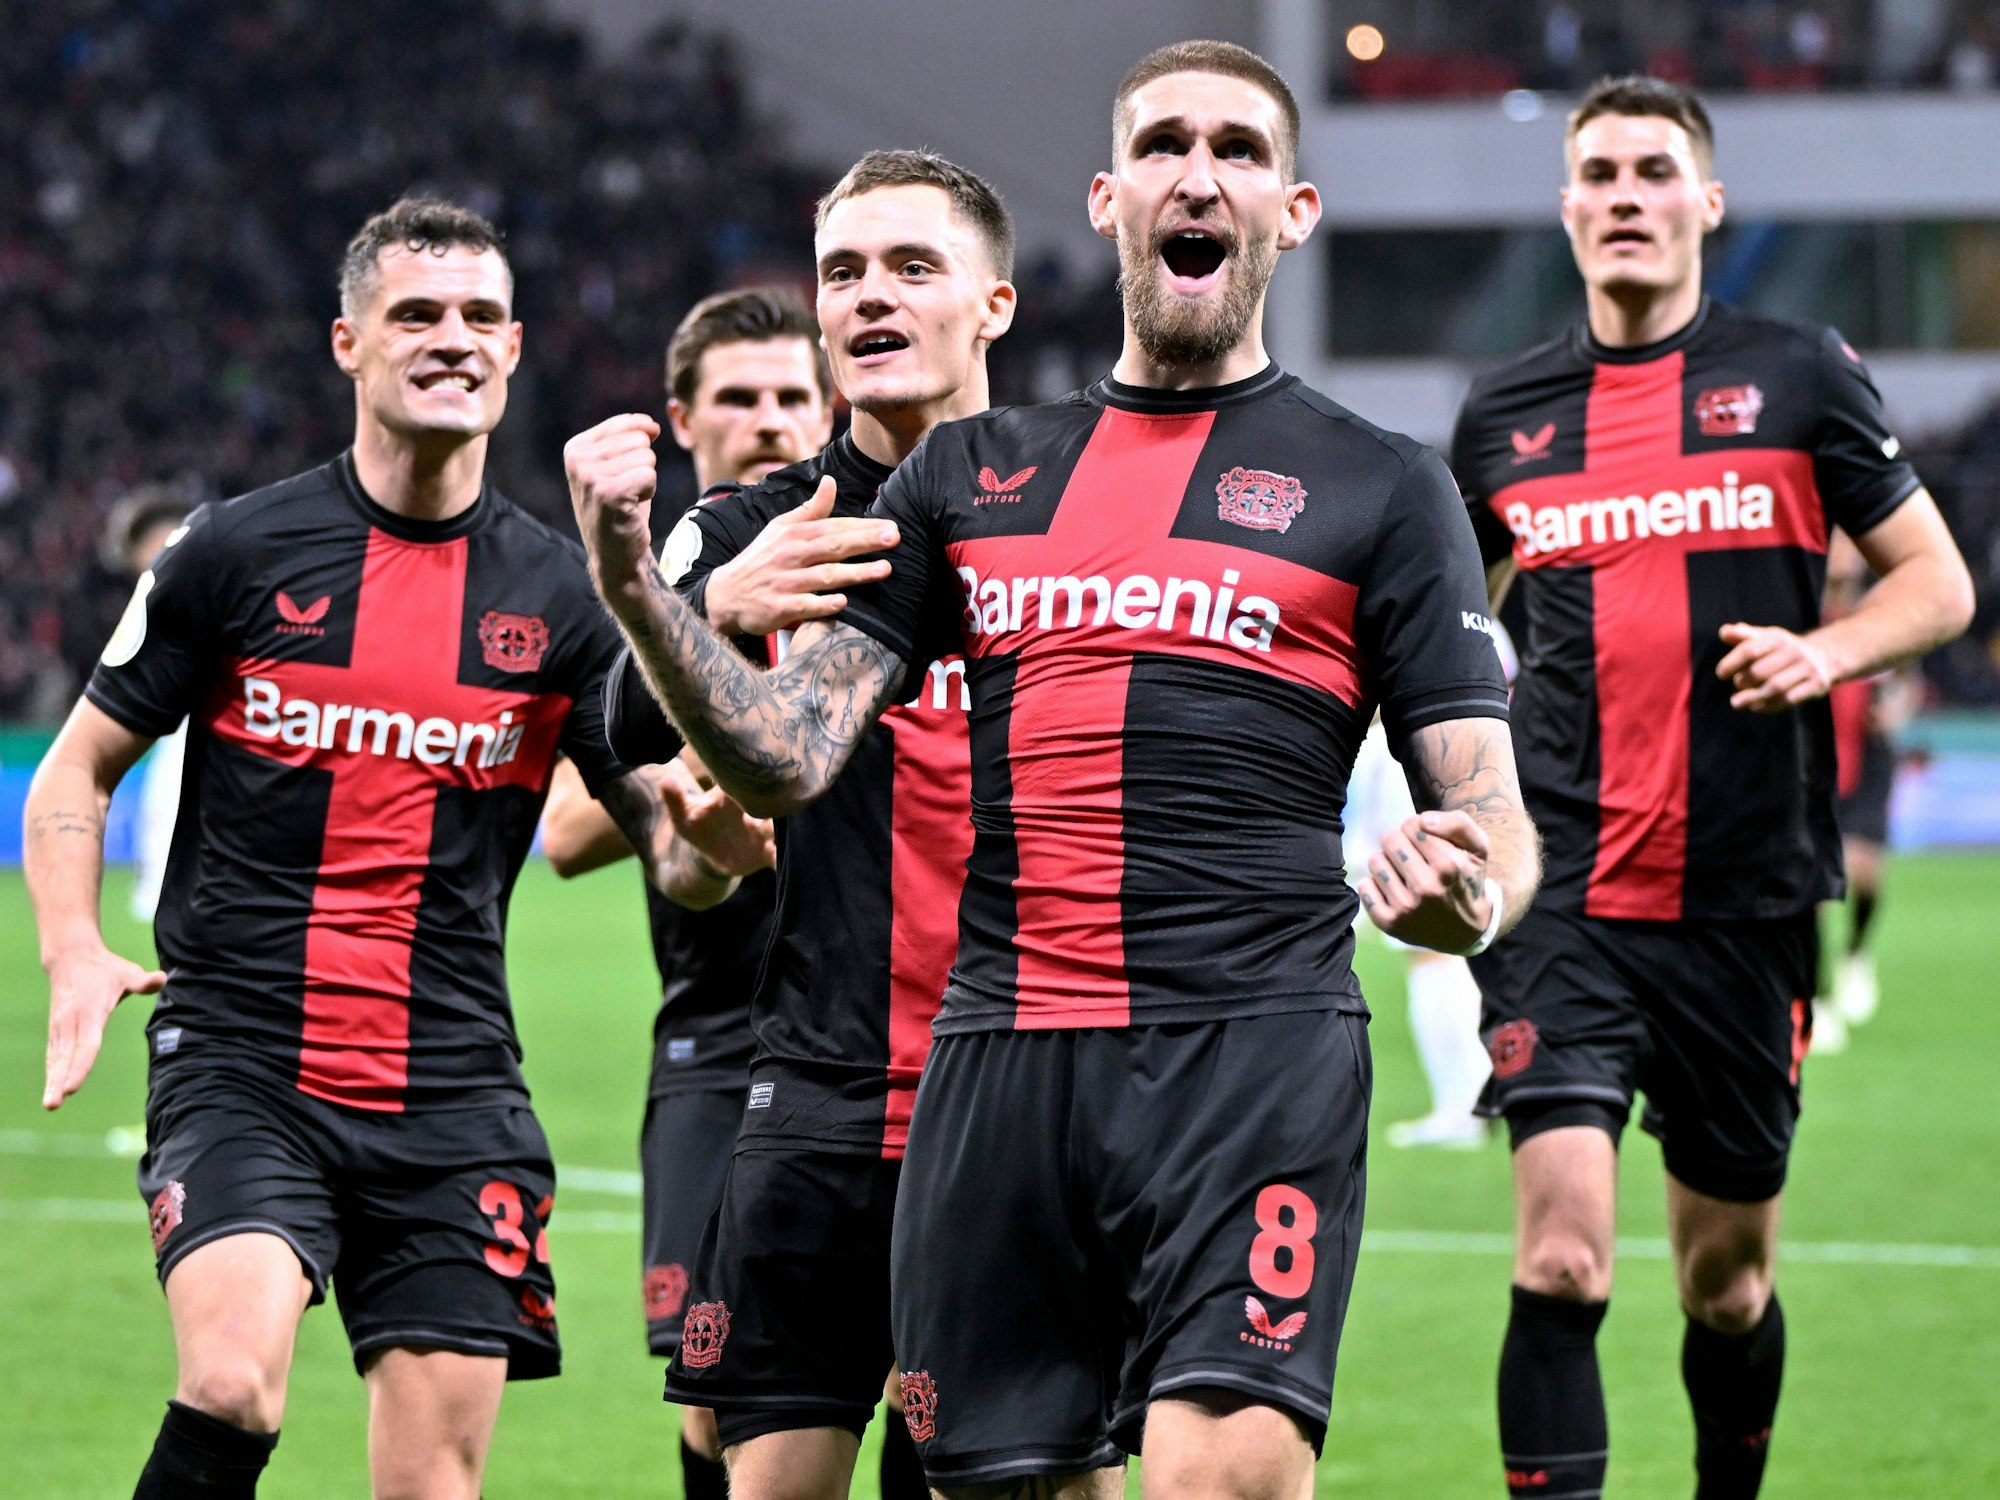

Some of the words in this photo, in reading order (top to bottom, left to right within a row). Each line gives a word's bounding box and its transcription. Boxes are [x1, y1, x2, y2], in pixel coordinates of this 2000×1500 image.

[974, 495, 1021, 506] CASTORE
[1505, 471, 1774, 557] Barmenia
[957, 567, 1280, 652] Barmenia
[244, 676, 525, 768] Barmenia
[1249, 1184, 1317, 1298] 8
